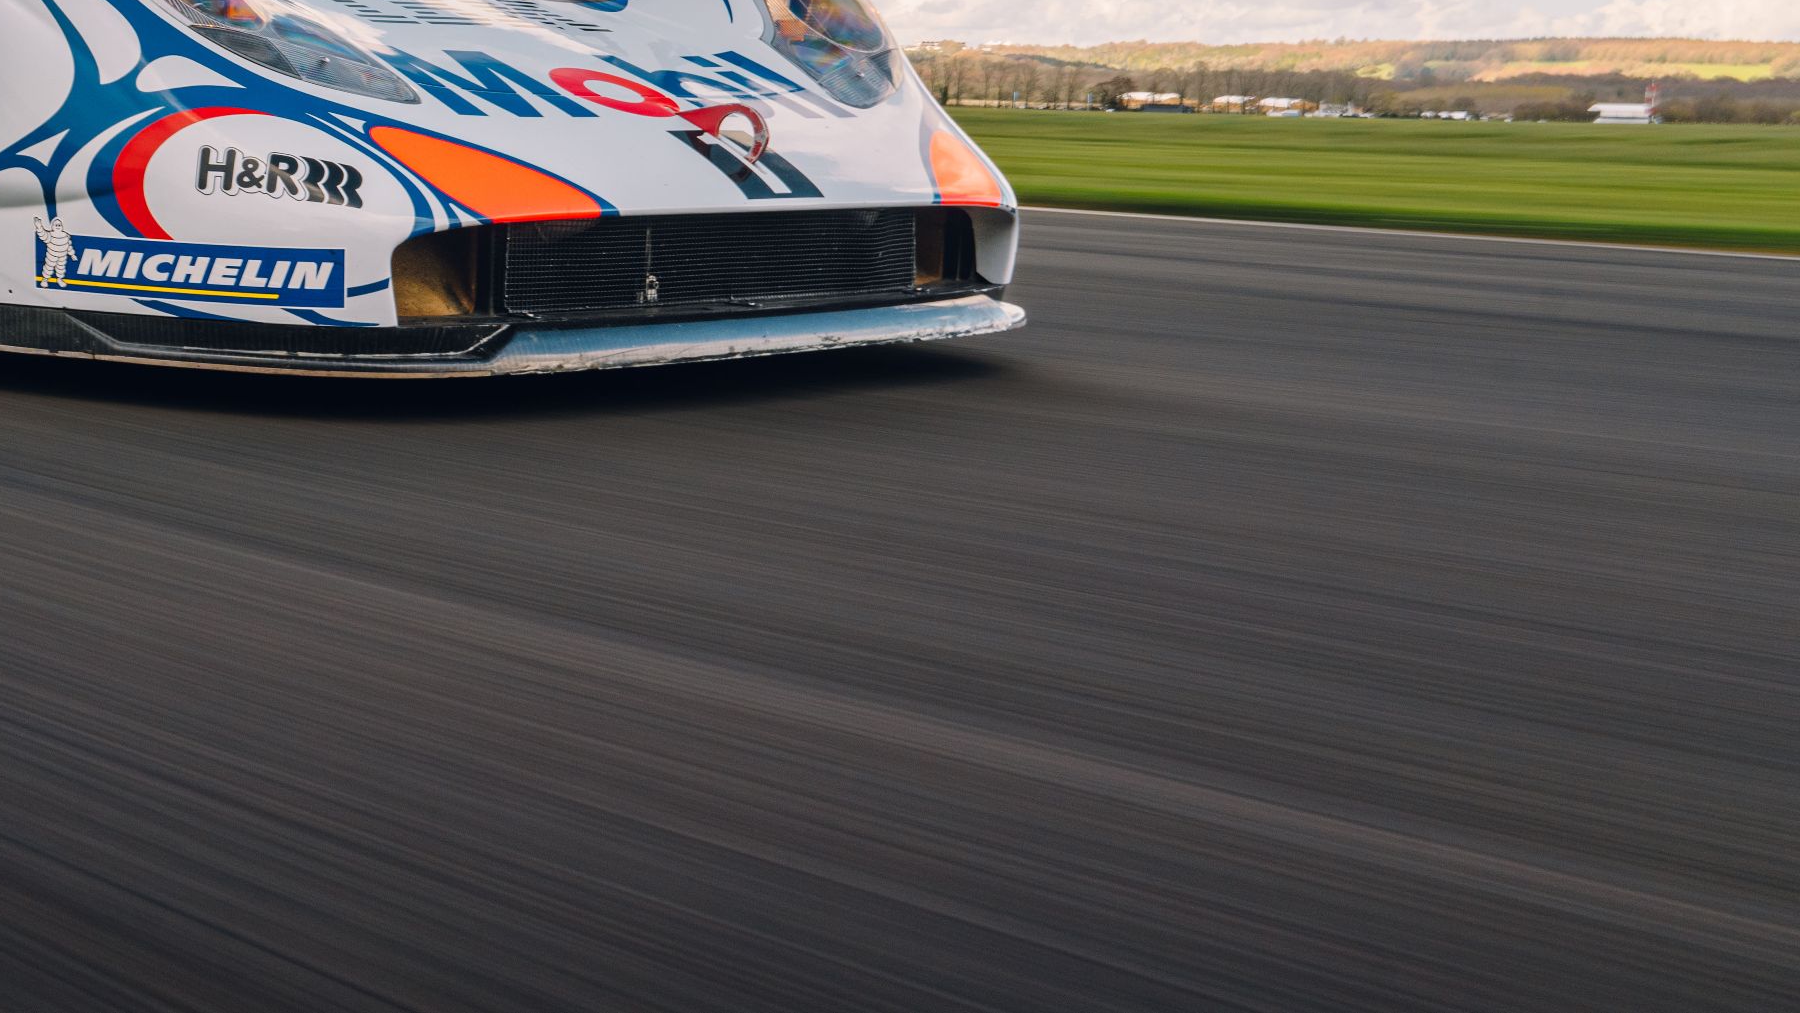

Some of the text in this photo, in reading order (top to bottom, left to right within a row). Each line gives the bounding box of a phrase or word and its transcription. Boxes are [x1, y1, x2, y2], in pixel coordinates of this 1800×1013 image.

[374, 50, 857, 118] Mobil
[195, 144, 310, 202] H&R
[77, 249, 334, 289] MICHELIN
